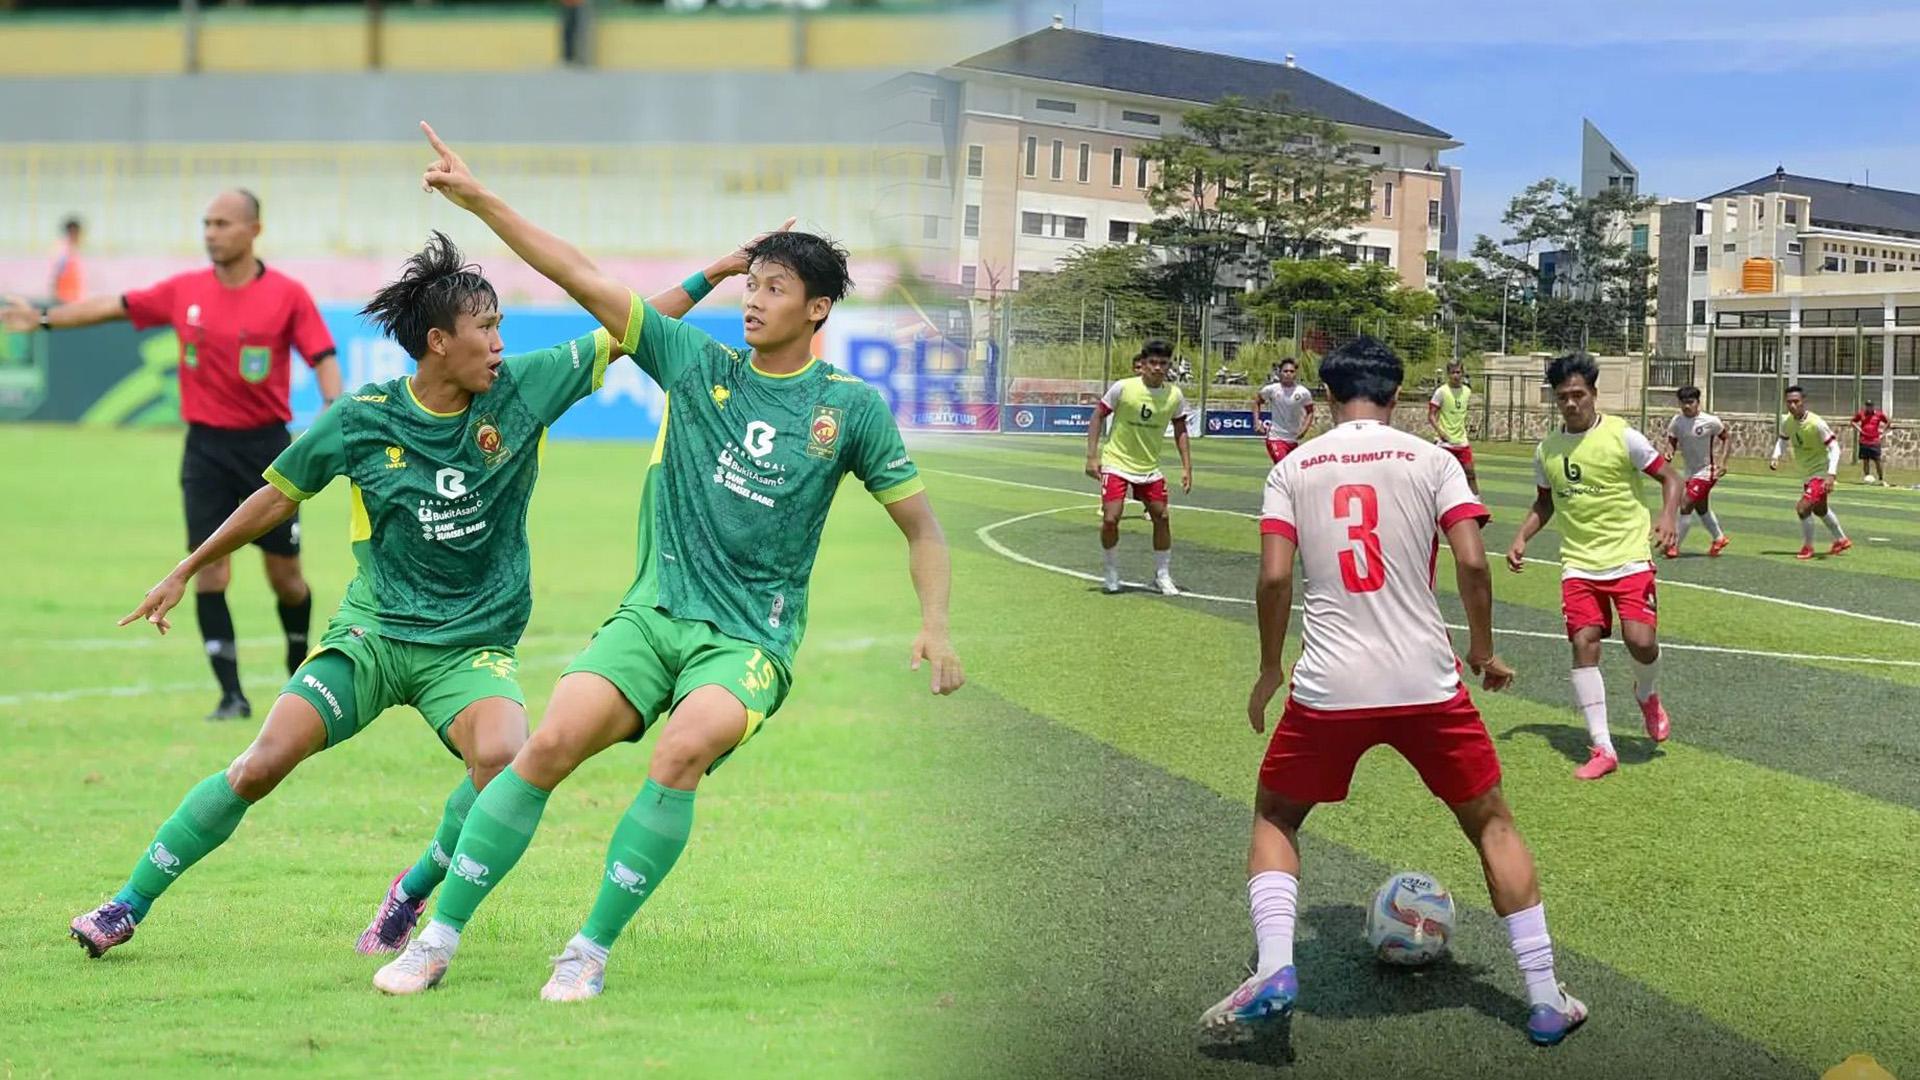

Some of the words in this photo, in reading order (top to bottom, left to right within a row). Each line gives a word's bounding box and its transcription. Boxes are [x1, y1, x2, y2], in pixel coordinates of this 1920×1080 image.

[1223, 418, 1251, 429] SCL
[1300, 453, 1338, 469] SADA
[1341, 450, 1394, 463] SUMUT
[1397, 451, 1416, 461] FC
[731, 461, 777, 487] BukitAsam
[432, 506, 478, 521] BukitAsam
[434, 522, 455, 533] BANK
[1333, 484, 1386, 593] 3
[312, 680, 344, 721] MANSPORT
